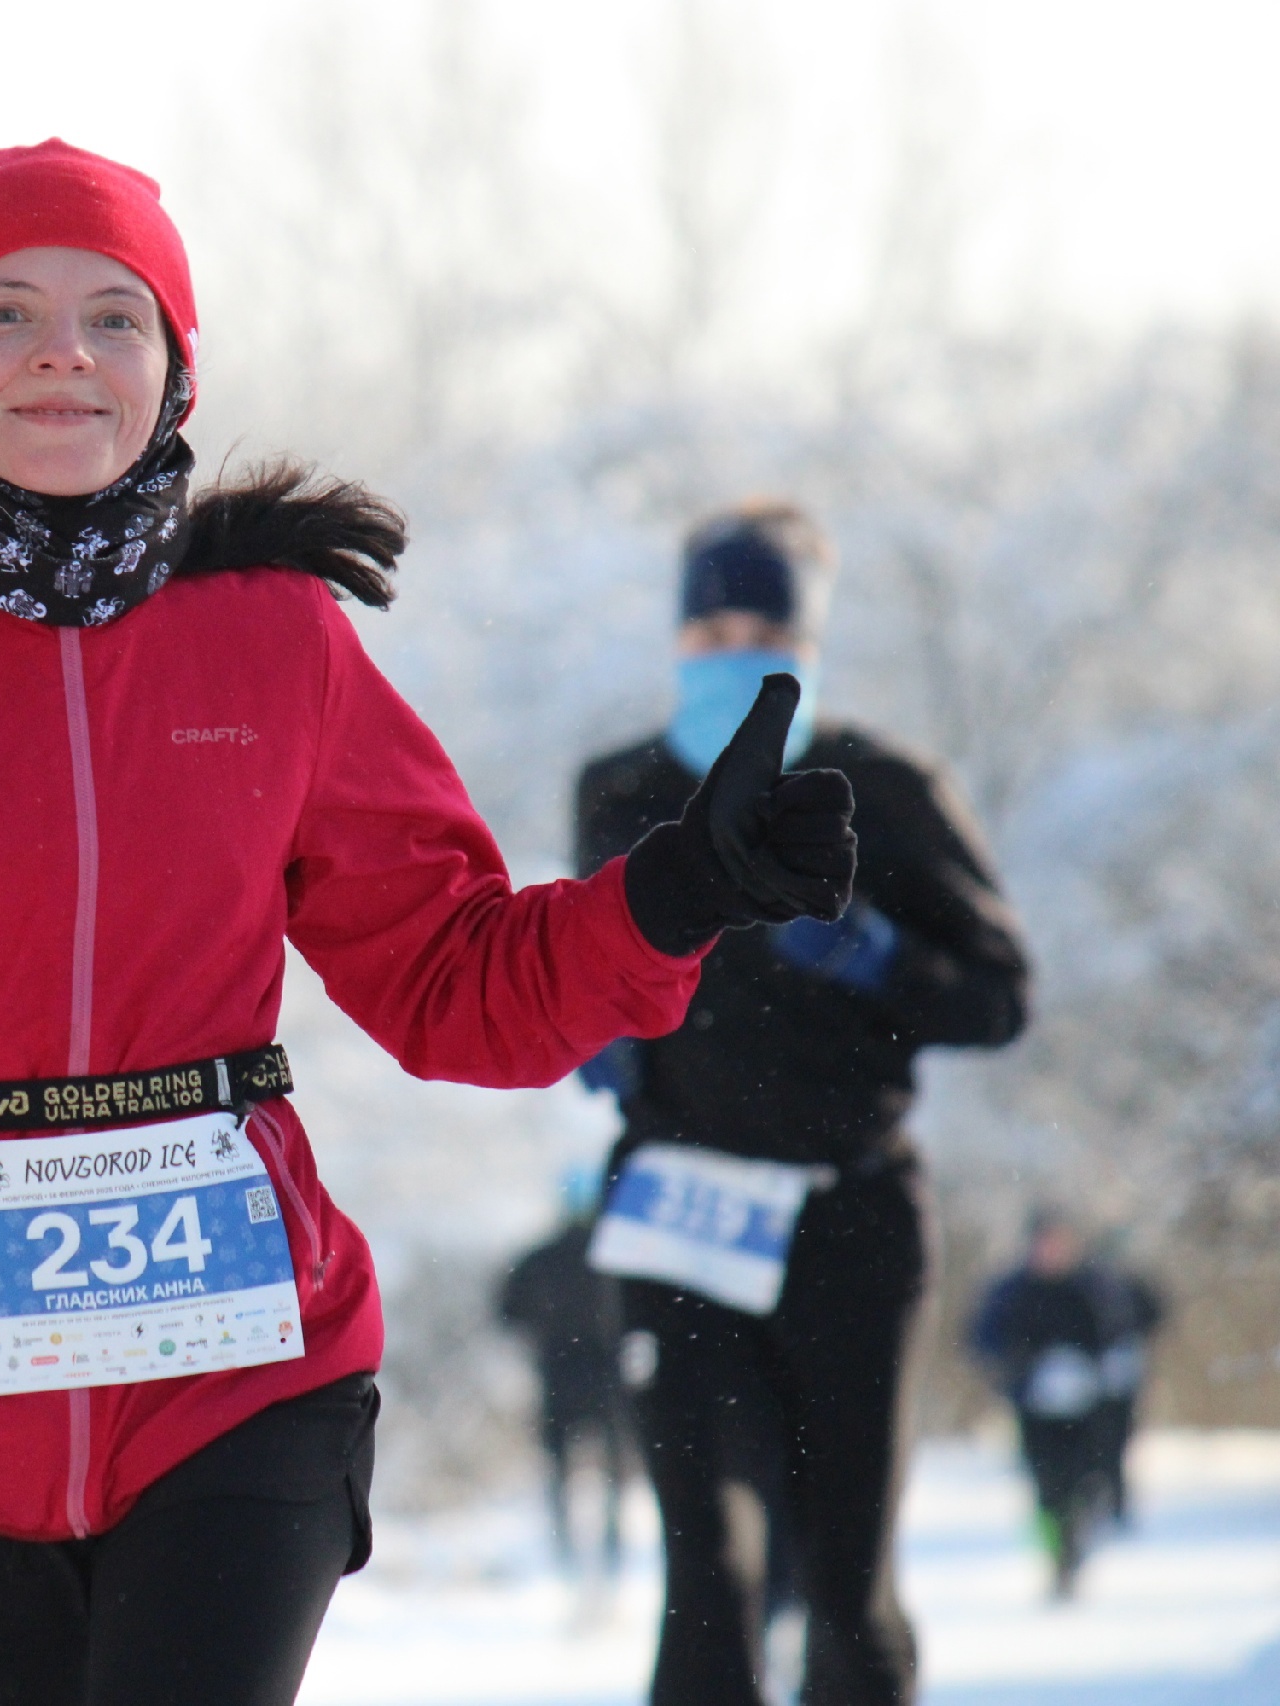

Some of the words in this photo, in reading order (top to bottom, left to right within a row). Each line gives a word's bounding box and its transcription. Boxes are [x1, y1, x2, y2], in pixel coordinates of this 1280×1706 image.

[171, 727, 239, 744] CRAFT
[43, 1080, 144, 1105] GOLDEN
[150, 1069, 202, 1094] RING
[44, 1102, 112, 1122] ULTRA
[118, 1095, 171, 1115] TRAIL
[173, 1088, 204, 1106] 100
[25, 1148, 152, 1183] NOVGOROD
[160, 1140, 196, 1169] ICE
[26, 1195, 212, 1291] 234
[45, 1287, 149, 1311] ГЛАДСКИХ
[152, 1277, 205, 1298] АННА
